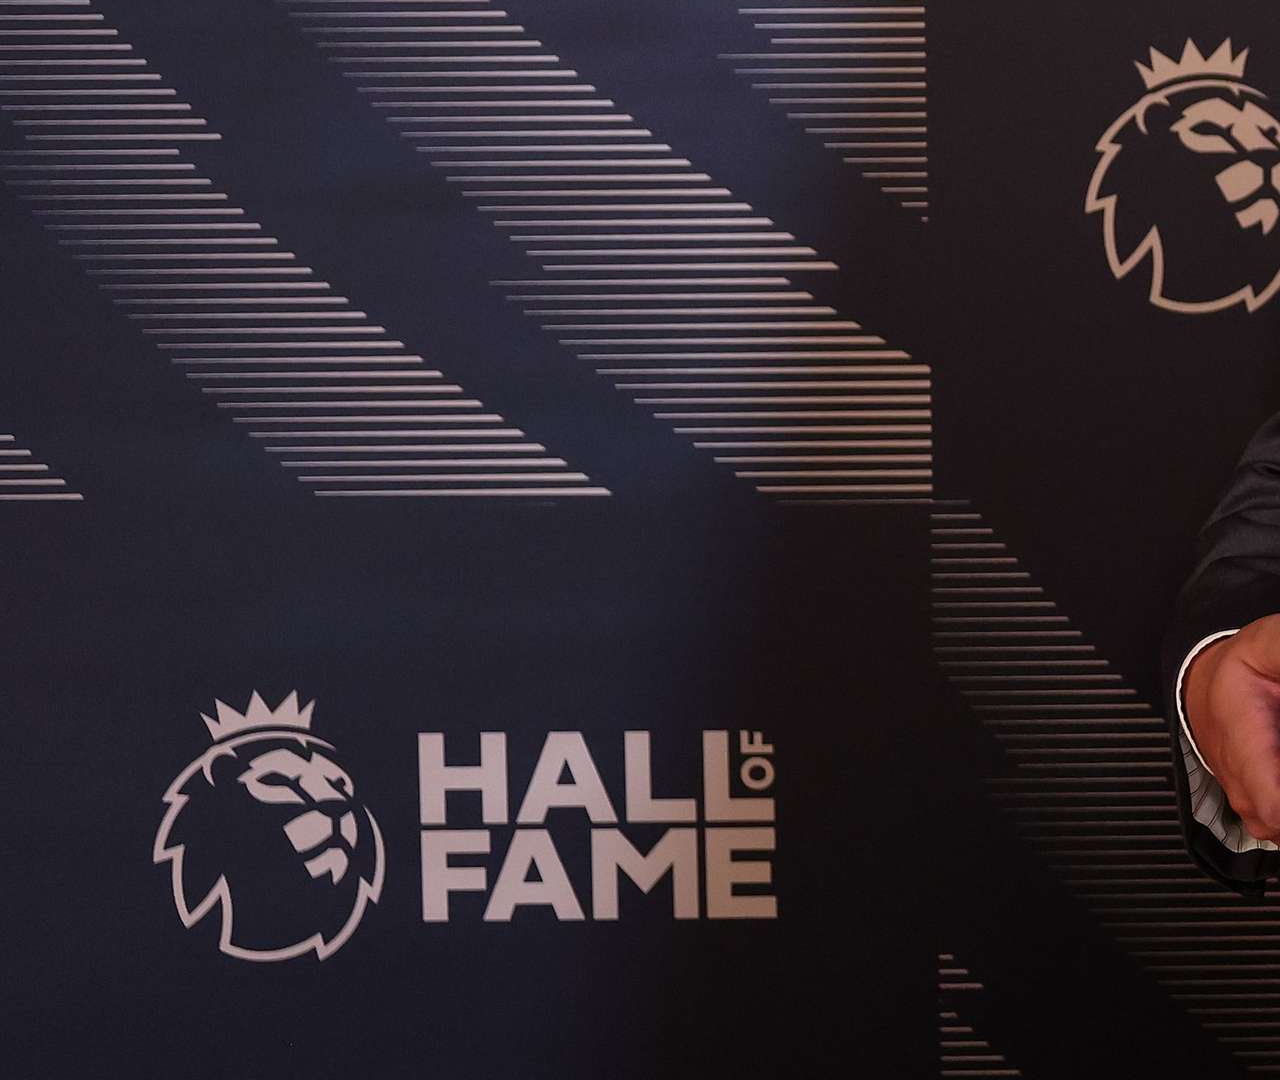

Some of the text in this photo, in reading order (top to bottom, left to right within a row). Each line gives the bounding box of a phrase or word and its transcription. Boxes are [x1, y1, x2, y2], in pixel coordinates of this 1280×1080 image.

[418, 729, 776, 824] HALL OF
[421, 826, 778, 922] FAME
